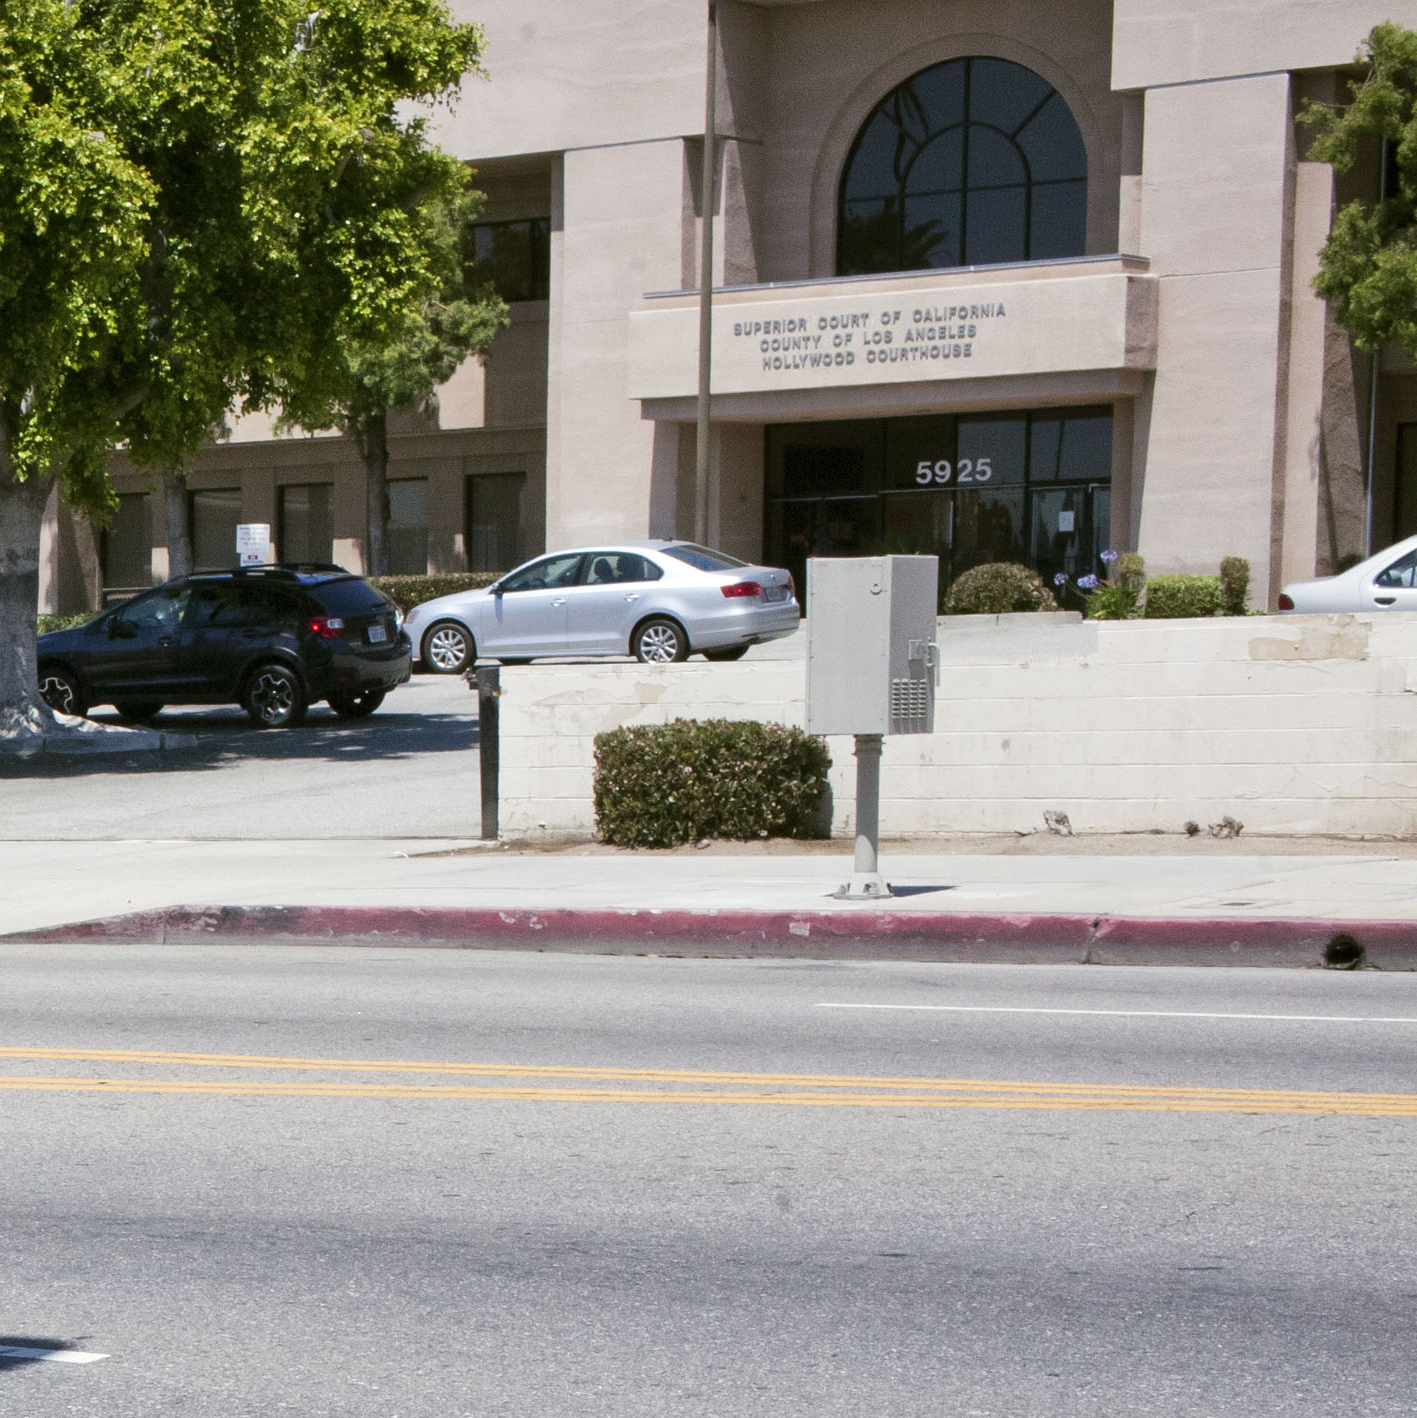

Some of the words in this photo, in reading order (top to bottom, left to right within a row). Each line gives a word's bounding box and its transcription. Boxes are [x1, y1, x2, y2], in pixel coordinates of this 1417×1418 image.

[733, 317, 808, 337] SUPERIOR
[818, 313, 870, 330] COURT
[882, 310, 902, 326] OF
[913, 303, 1007, 324] CALIFORNIA
[761, 335, 822, 353] COUNTY
[833, 332, 853, 348] OF
[864, 330, 893, 345] LOS
[905, 324, 977, 343] ANGELES
[763, 352, 855, 371] HOLLYWOOD
[866, 343, 973, 364] COURTHOUSE
[916, 458, 993, 484] 5925
